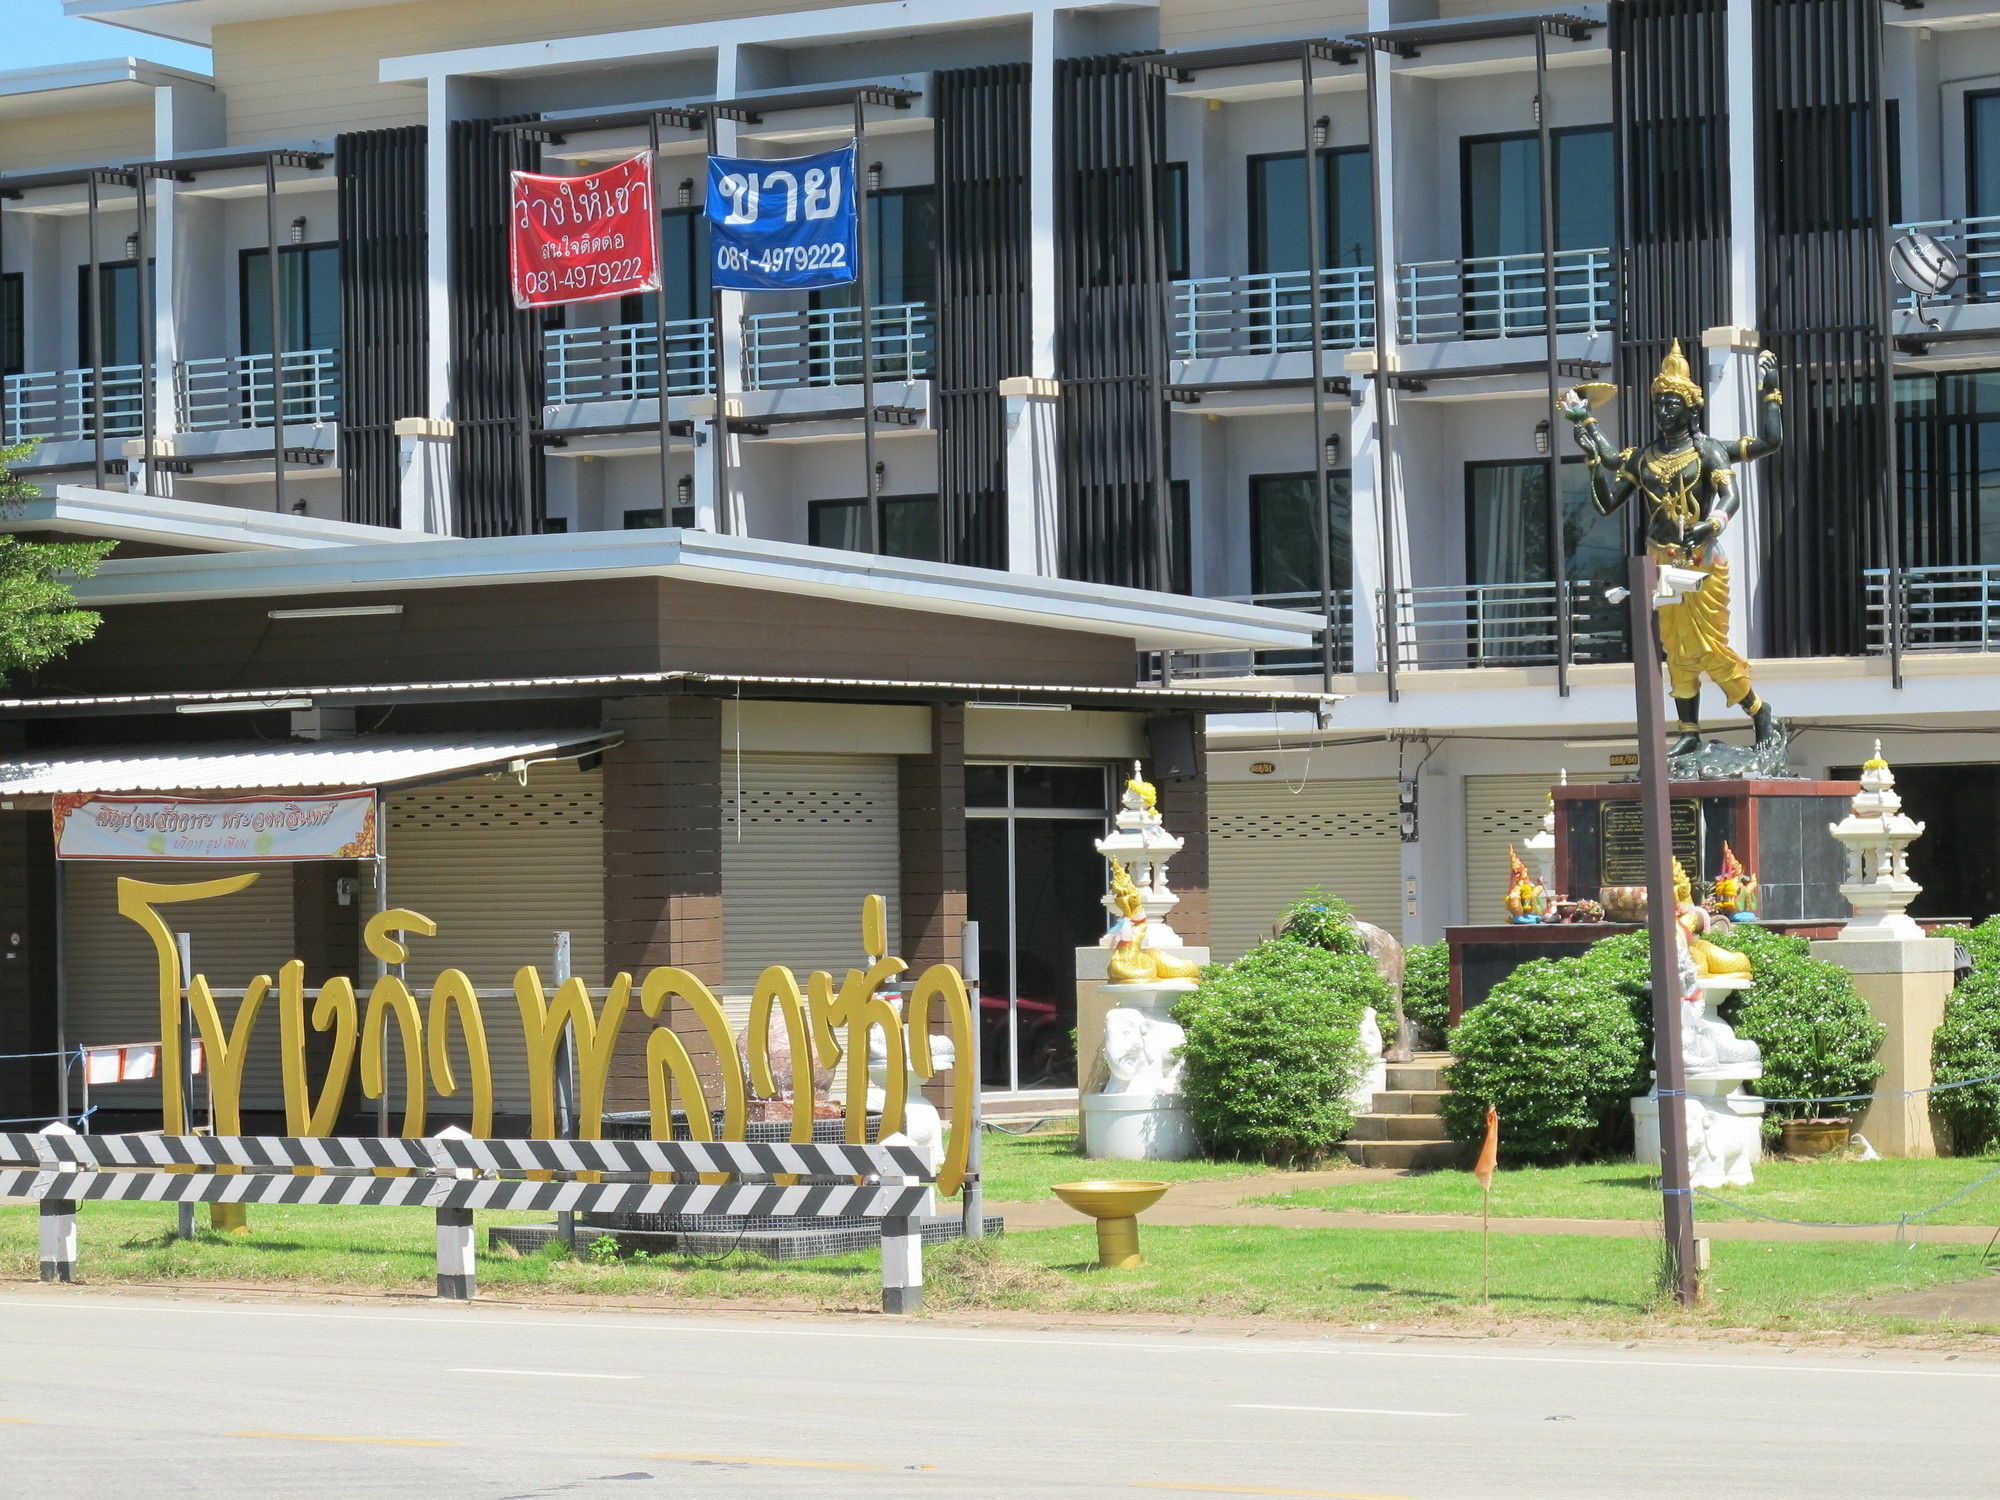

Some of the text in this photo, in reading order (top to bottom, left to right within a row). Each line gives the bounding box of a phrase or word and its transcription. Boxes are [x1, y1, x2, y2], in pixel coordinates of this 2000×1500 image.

[515, 166, 647, 228] ว่างให้เช่า
[718, 166, 841, 224] ขาย
[541, 227, 625, 259] สนใจติดต่อ
[717, 242, 847, 273] 081-4979222
[525, 257, 643, 294] 081-4979222
